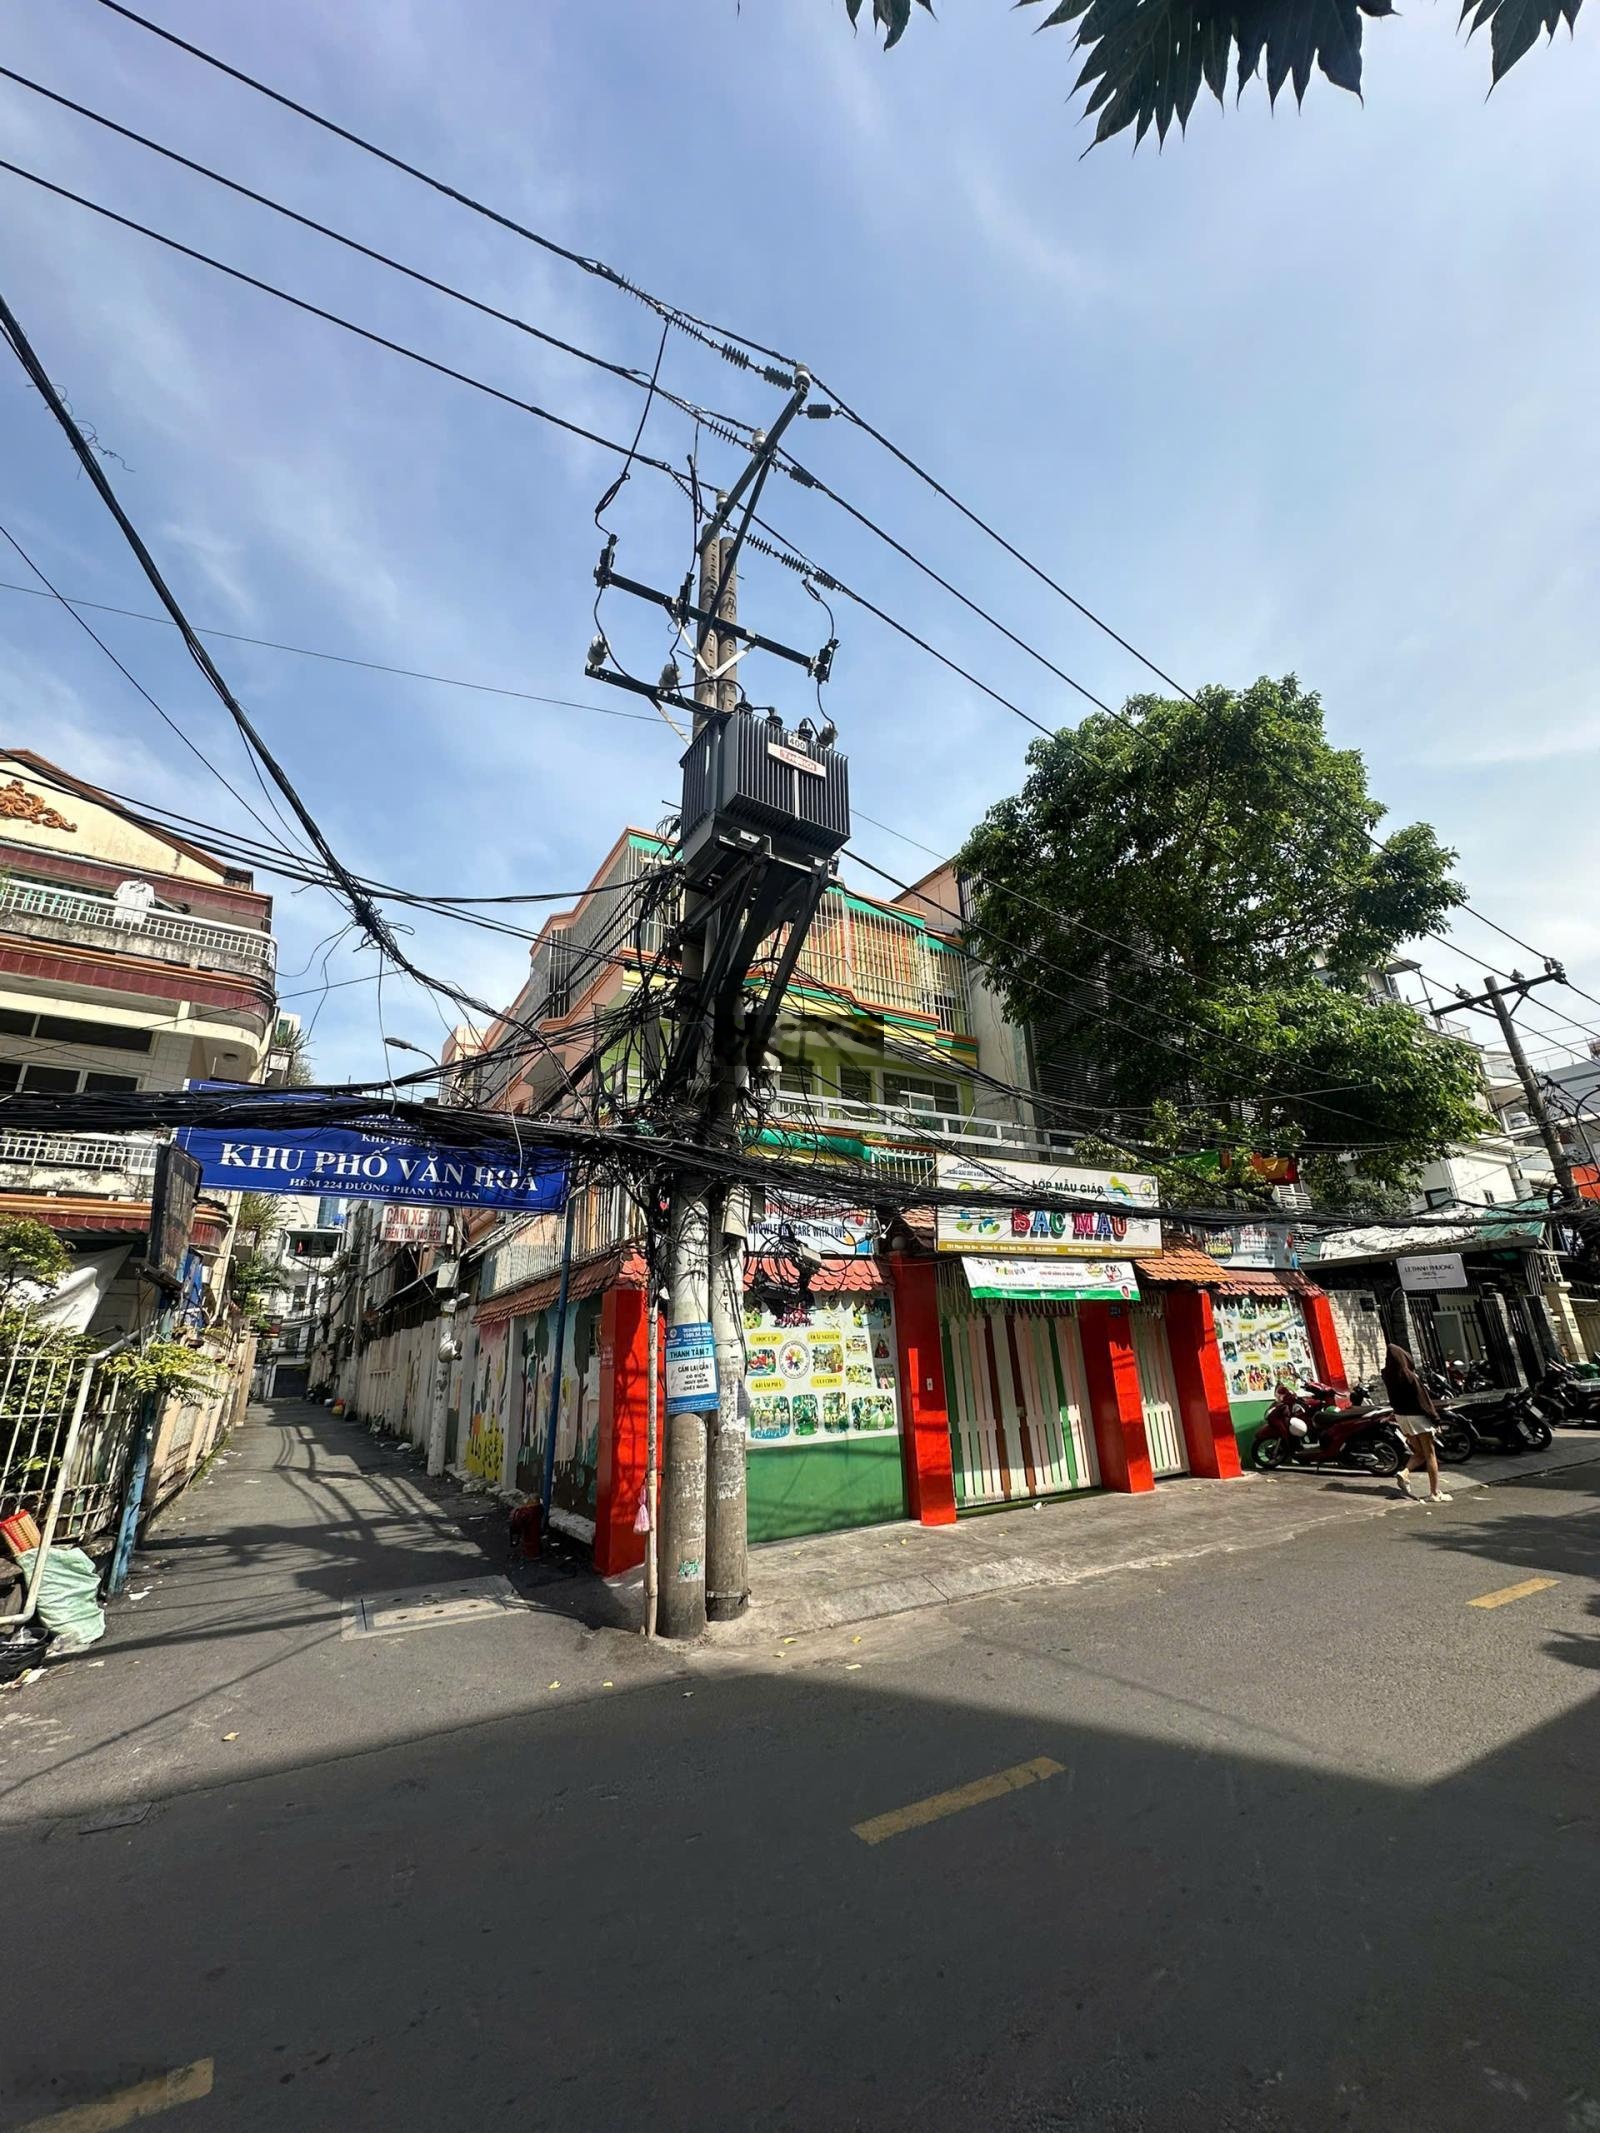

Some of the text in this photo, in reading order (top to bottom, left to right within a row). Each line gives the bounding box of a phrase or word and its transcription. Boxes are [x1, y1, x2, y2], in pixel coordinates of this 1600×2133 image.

[789, 738, 806, 750] 400
[219, 1142, 306, 1172] KHU
[312, 1146, 389, 1178] PHỐ
[398, 1154, 466, 1186] VĂN
[322, 1180, 343, 1189] 224
[393, 1185, 426, 1195] PHAN
[428, 1187, 453, 1197] VĂN
[1080, 1182, 1104, 1195] GIÁO
[411, 1208, 424, 1226] XE
[813, 1225, 830, 1238] WITH
[670, 1349, 690, 1359] THANH
[691, 1346, 705, 1356] TÂM
